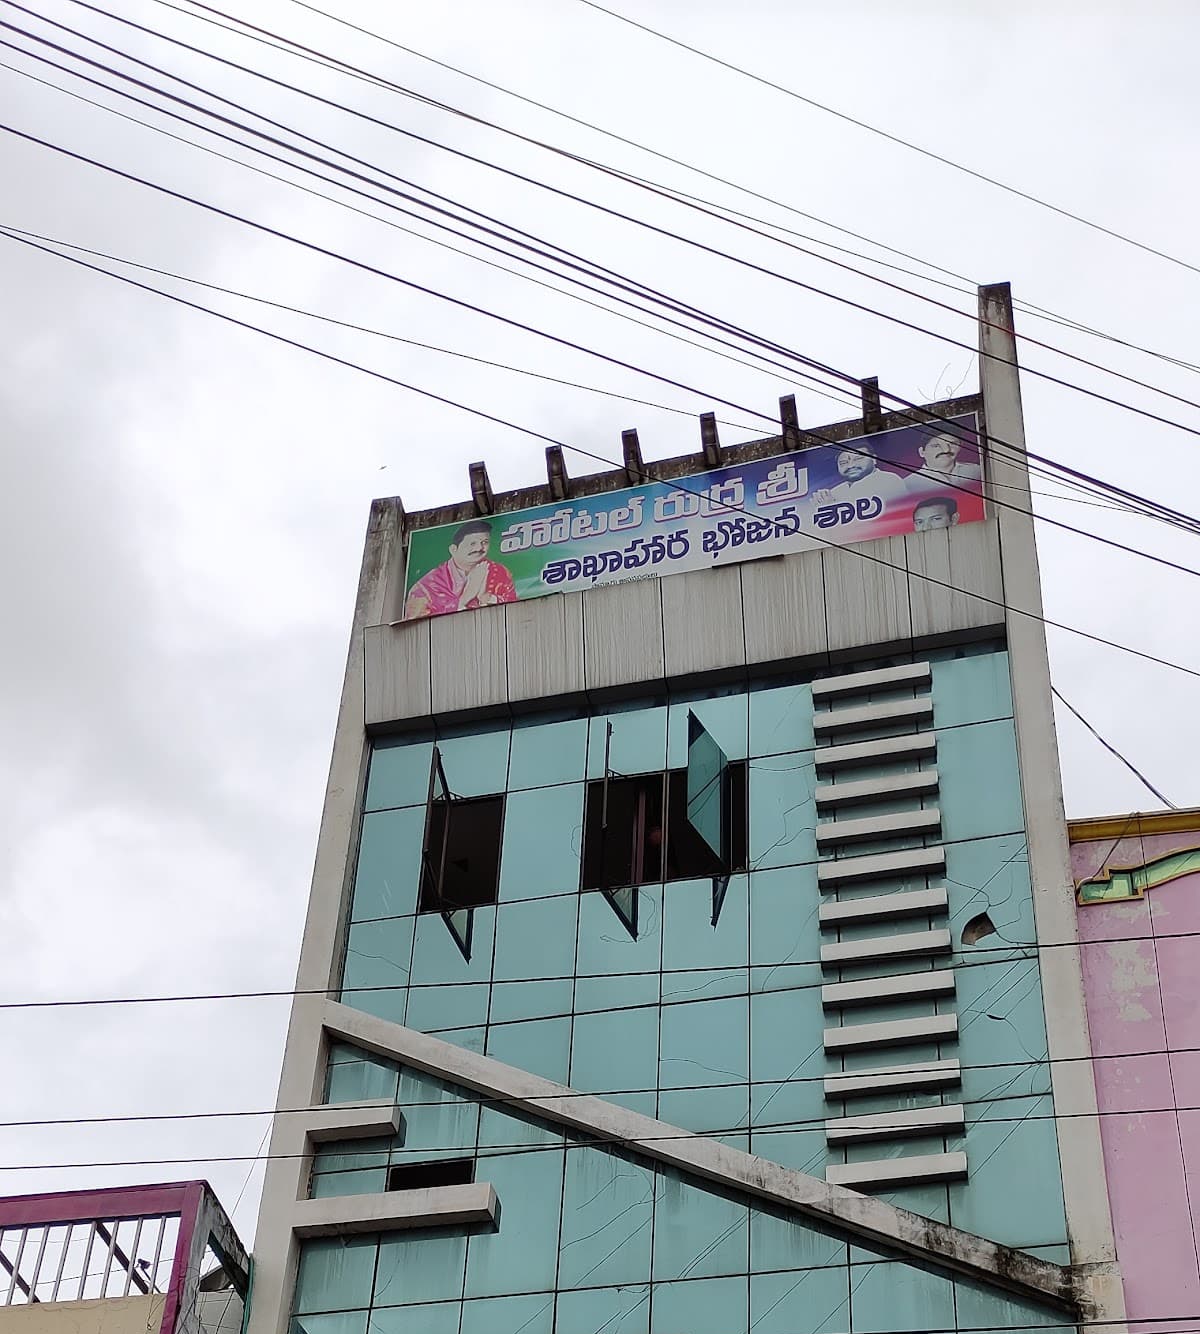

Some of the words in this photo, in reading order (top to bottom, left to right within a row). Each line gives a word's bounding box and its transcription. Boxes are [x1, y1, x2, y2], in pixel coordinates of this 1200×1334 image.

[500, 495, 645, 554] హోటల్
[653, 477, 745, 523] రుద్ర
[755, 459, 810, 507] శ్రీ
[542, 530, 690, 585] శాఖాహార
[702, 507, 801, 558] భోజన
[812, 493, 884, 531] శాల
